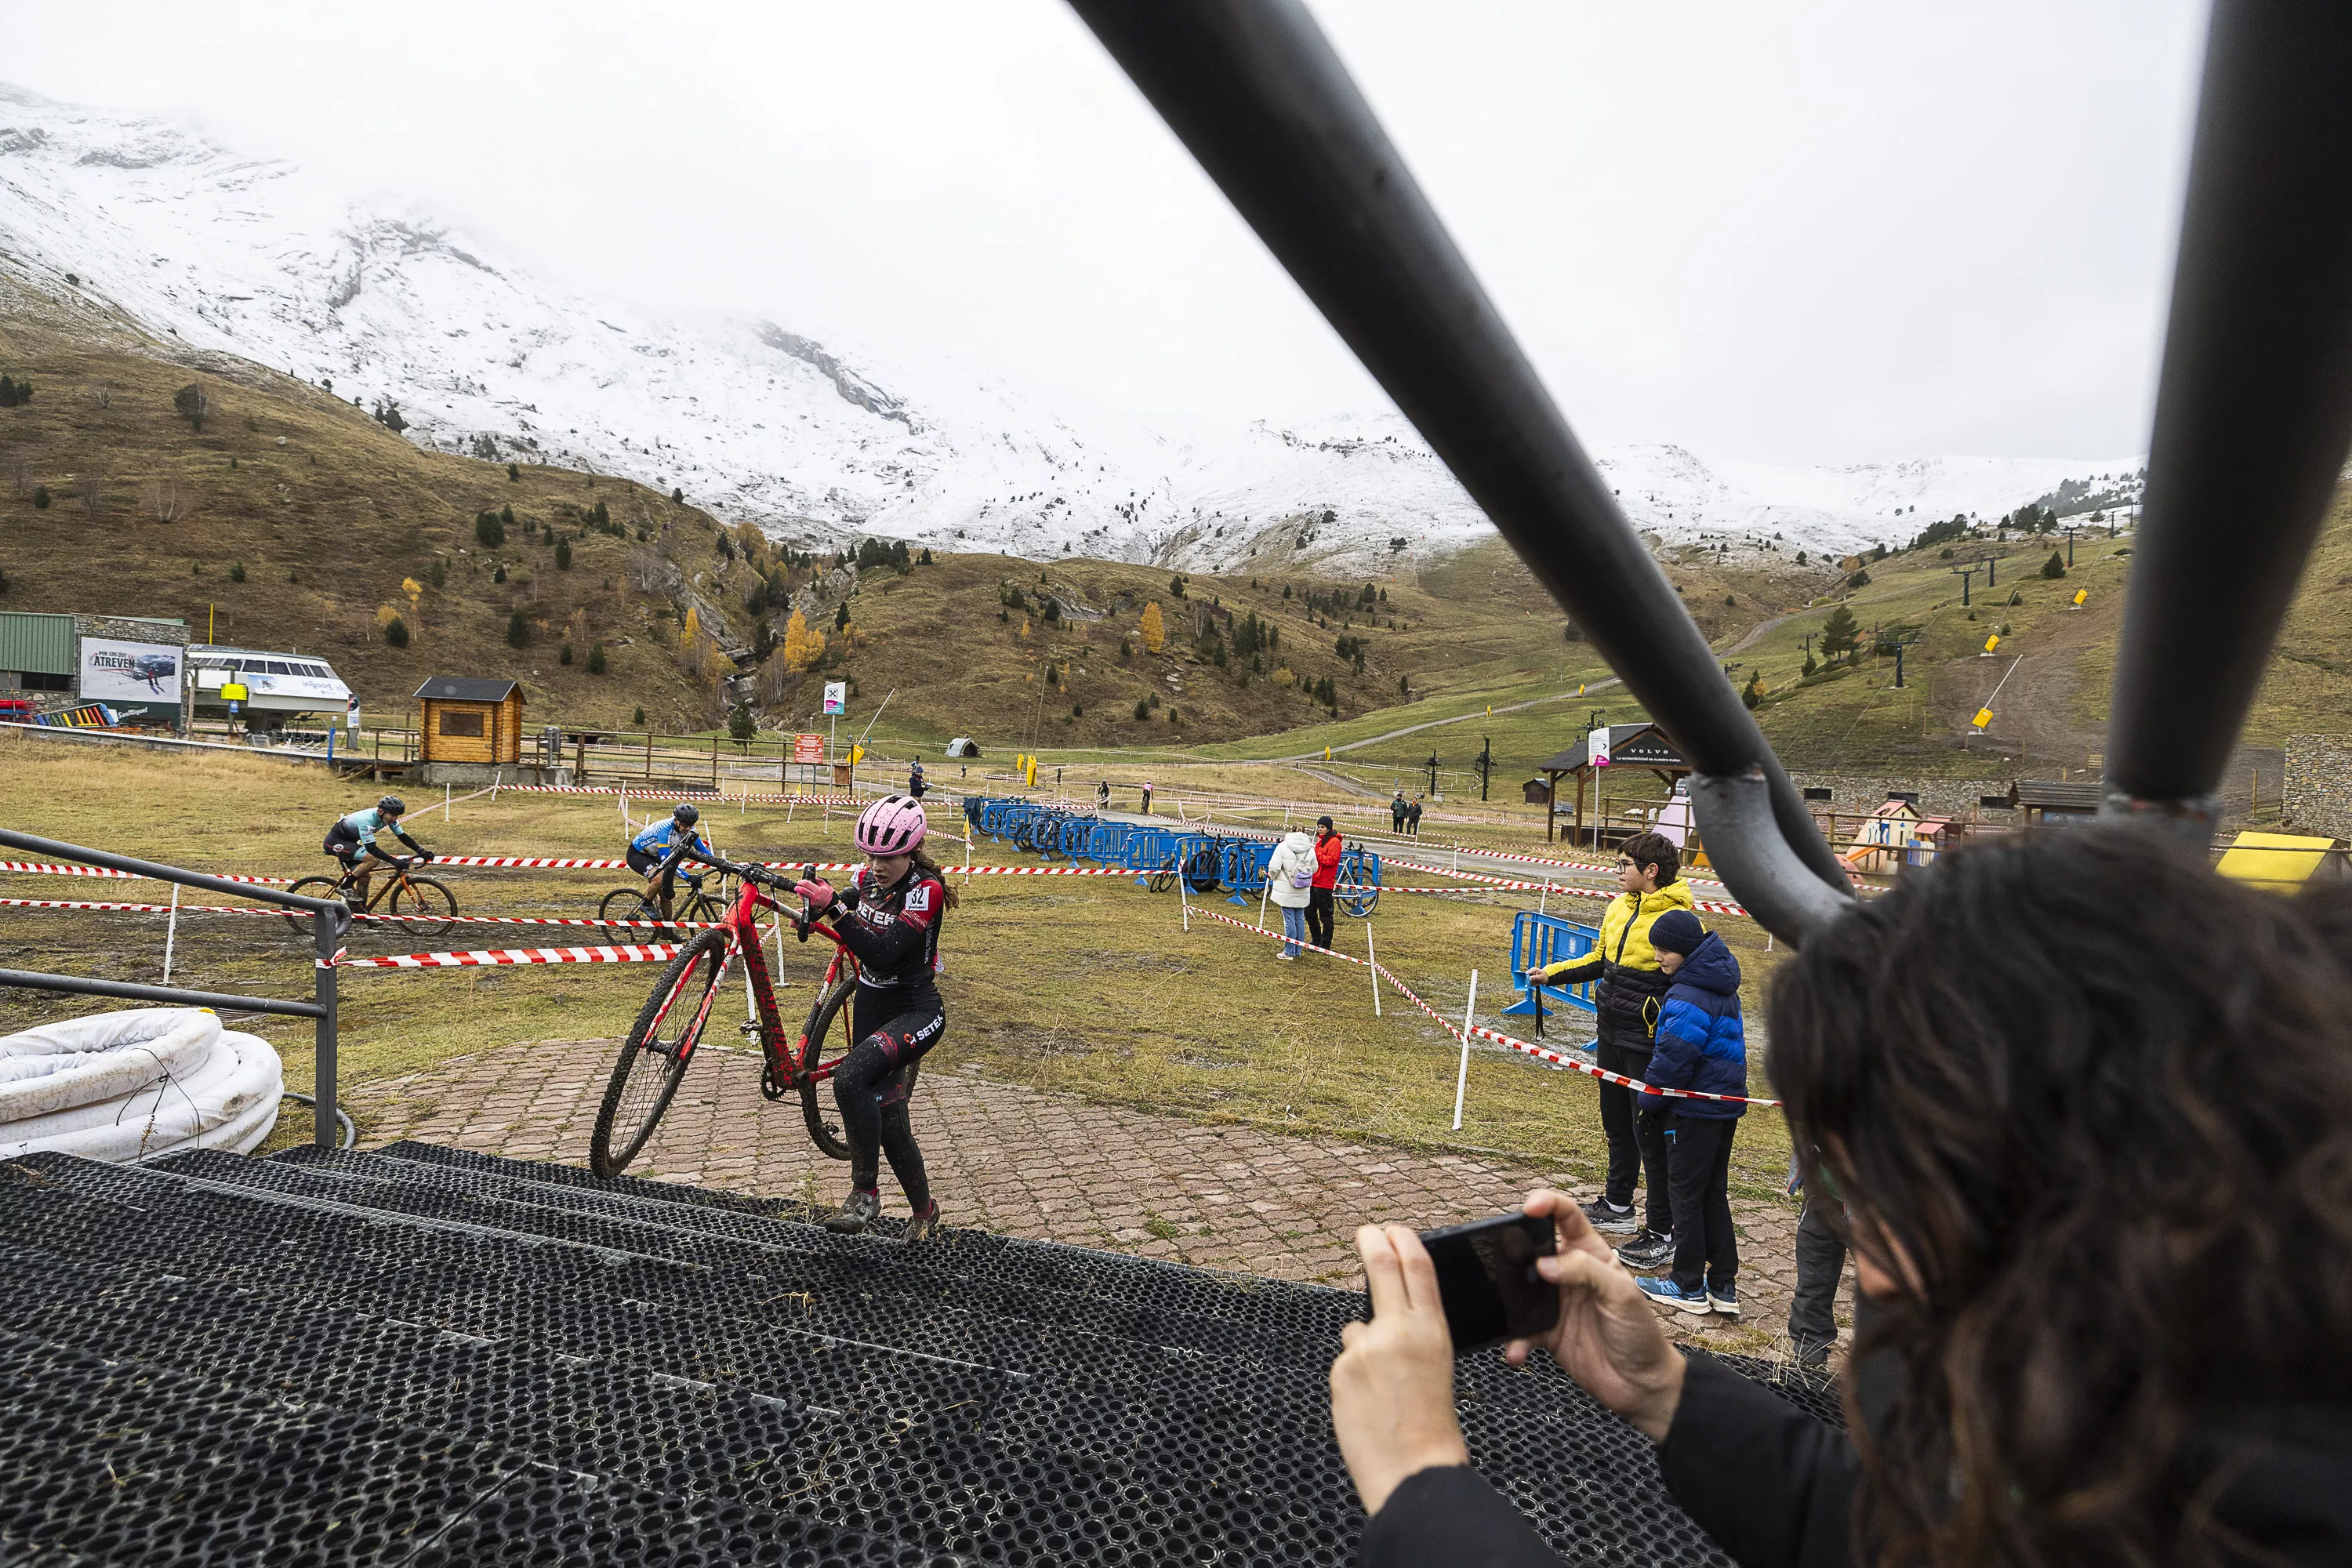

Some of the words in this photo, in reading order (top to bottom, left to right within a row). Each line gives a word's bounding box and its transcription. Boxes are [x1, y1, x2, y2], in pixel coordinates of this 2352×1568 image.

[94, 655, 135, 668] ATREVEN
[911, 888, 924, 904] 32
[857, 900, 898, 926] SETEK
[916, 1014, 943, 1040] SETEK
[1649, 1244, 1668, 1258] HOKA
